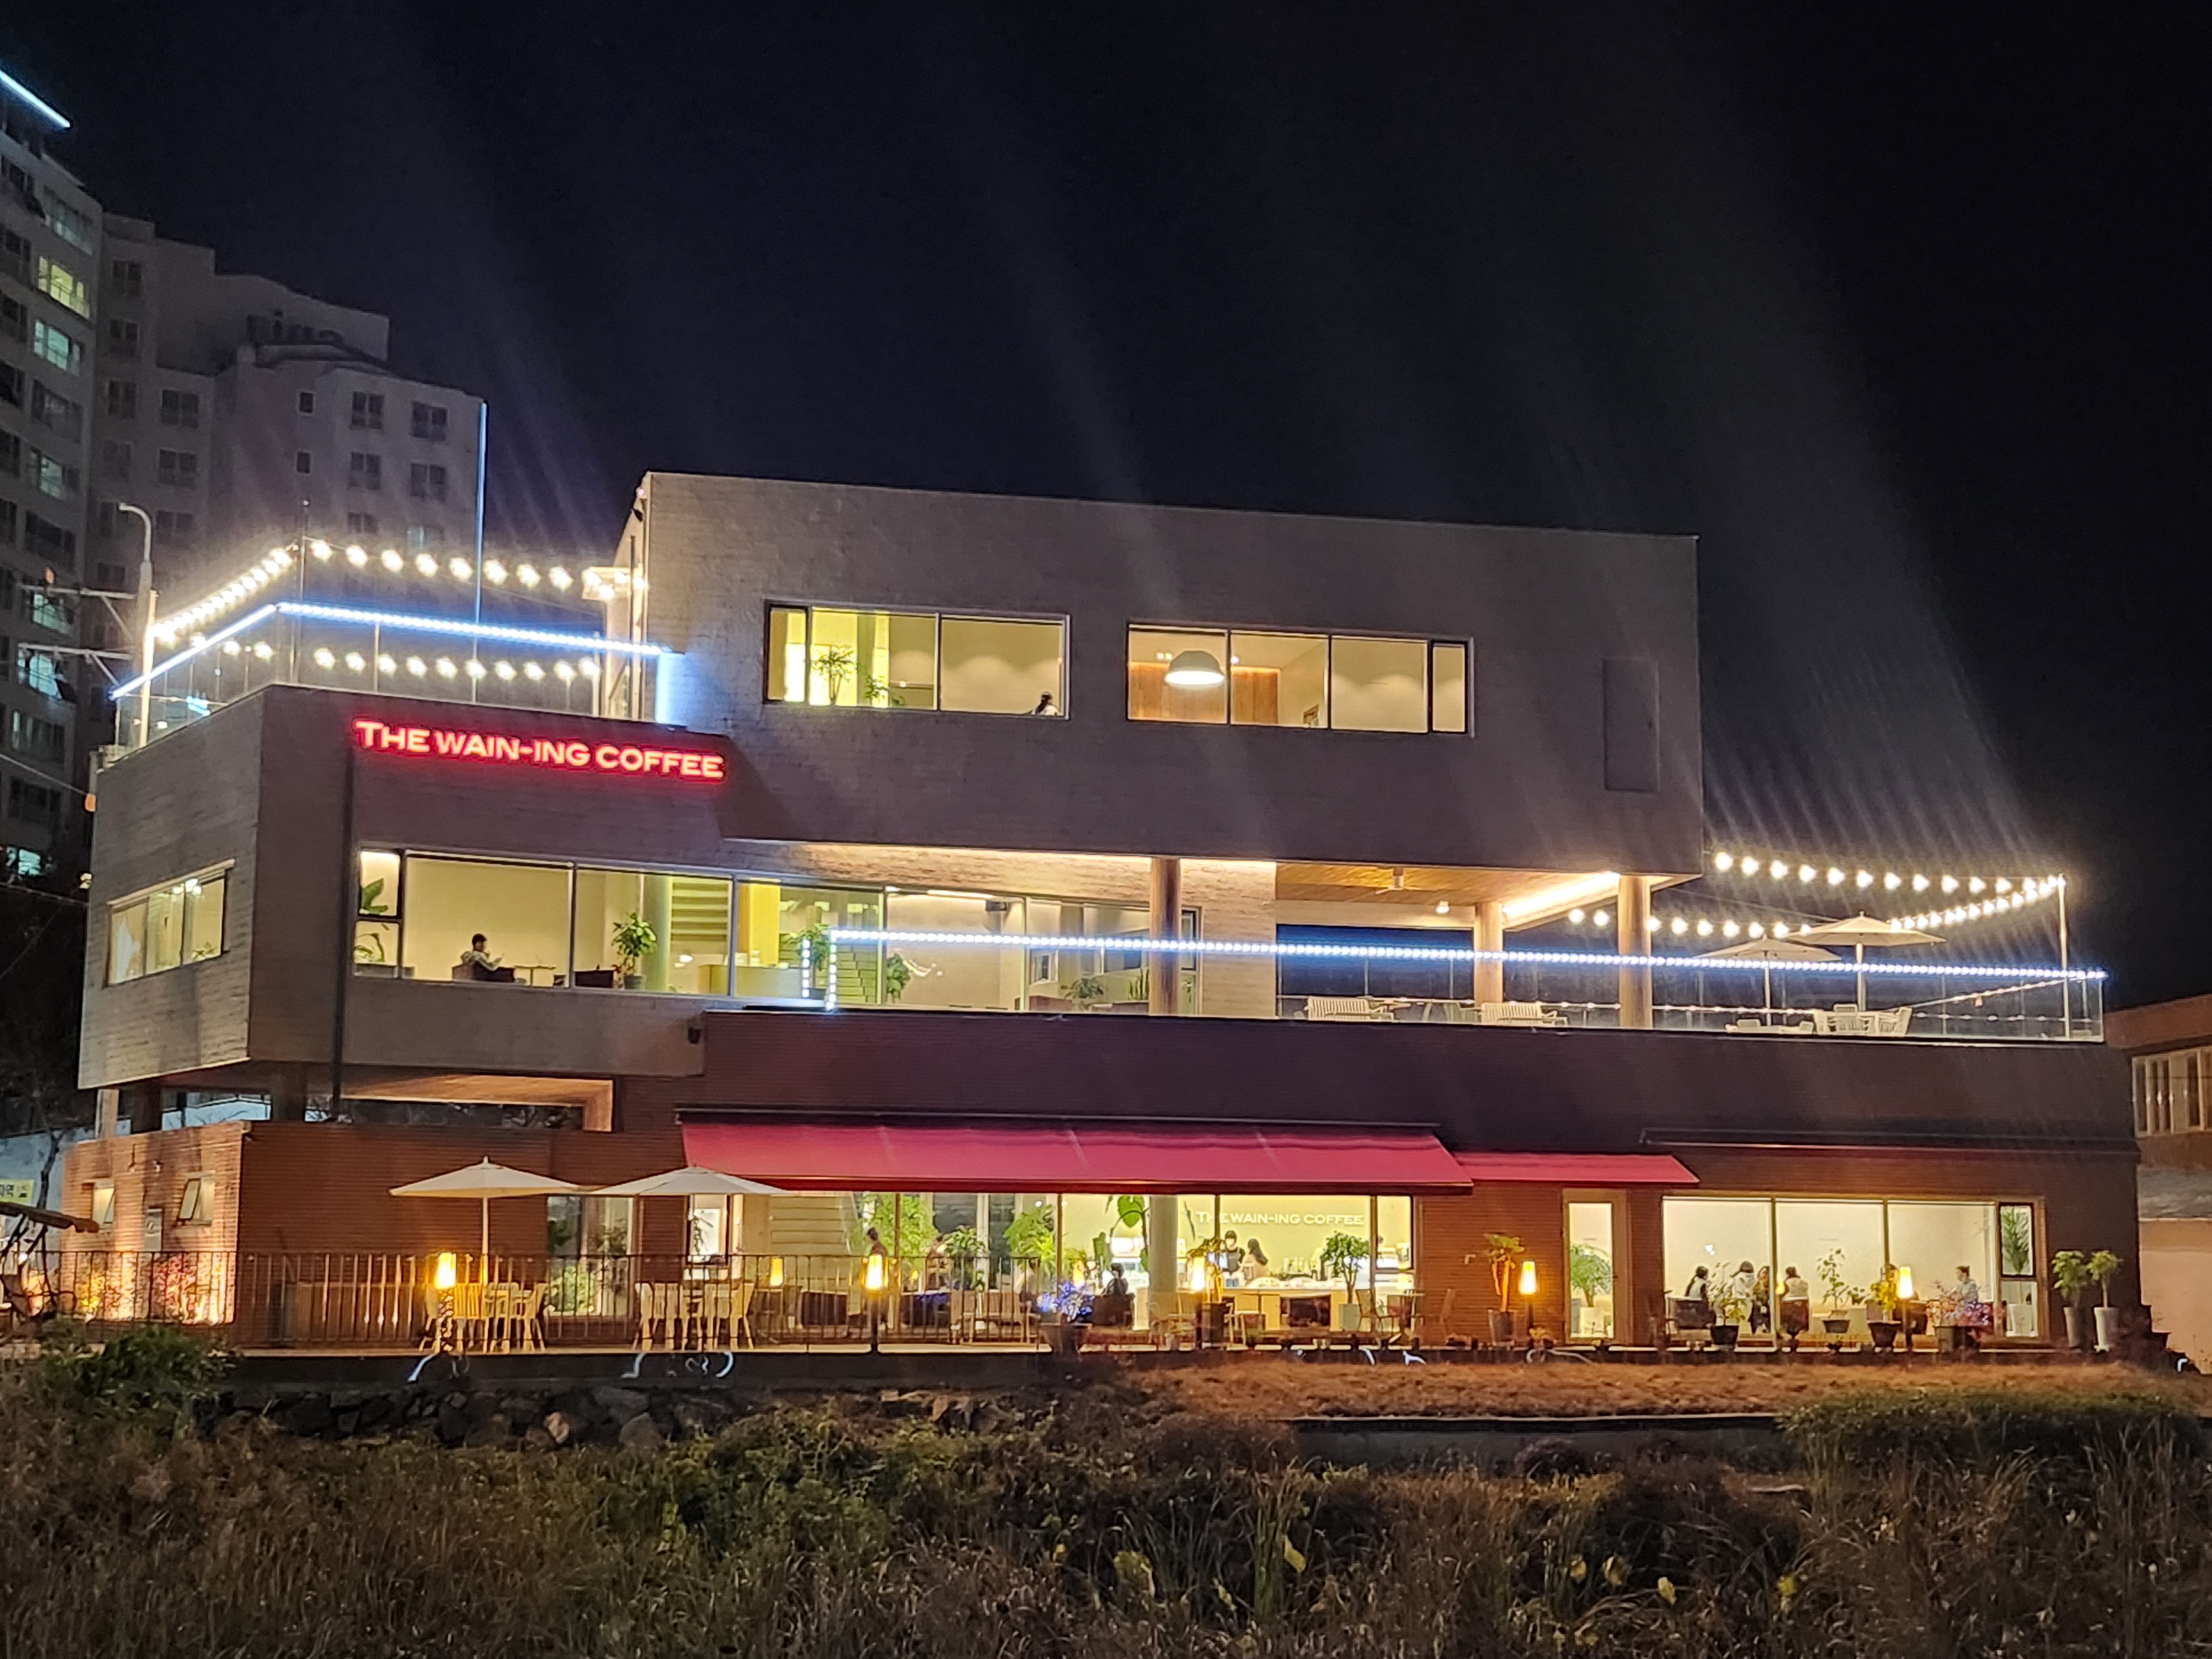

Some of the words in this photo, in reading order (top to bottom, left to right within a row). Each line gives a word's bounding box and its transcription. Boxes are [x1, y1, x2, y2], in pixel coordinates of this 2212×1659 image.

[356, 720, 430, 753] THE
[434, 730, 591, 767] WAIN-ING
[594, 745, 724, 778] COFFEE
[1229, 1213, 1301, 1224] WAIN-ING
[1303, 1214, 1364, 1225] COFFEE
